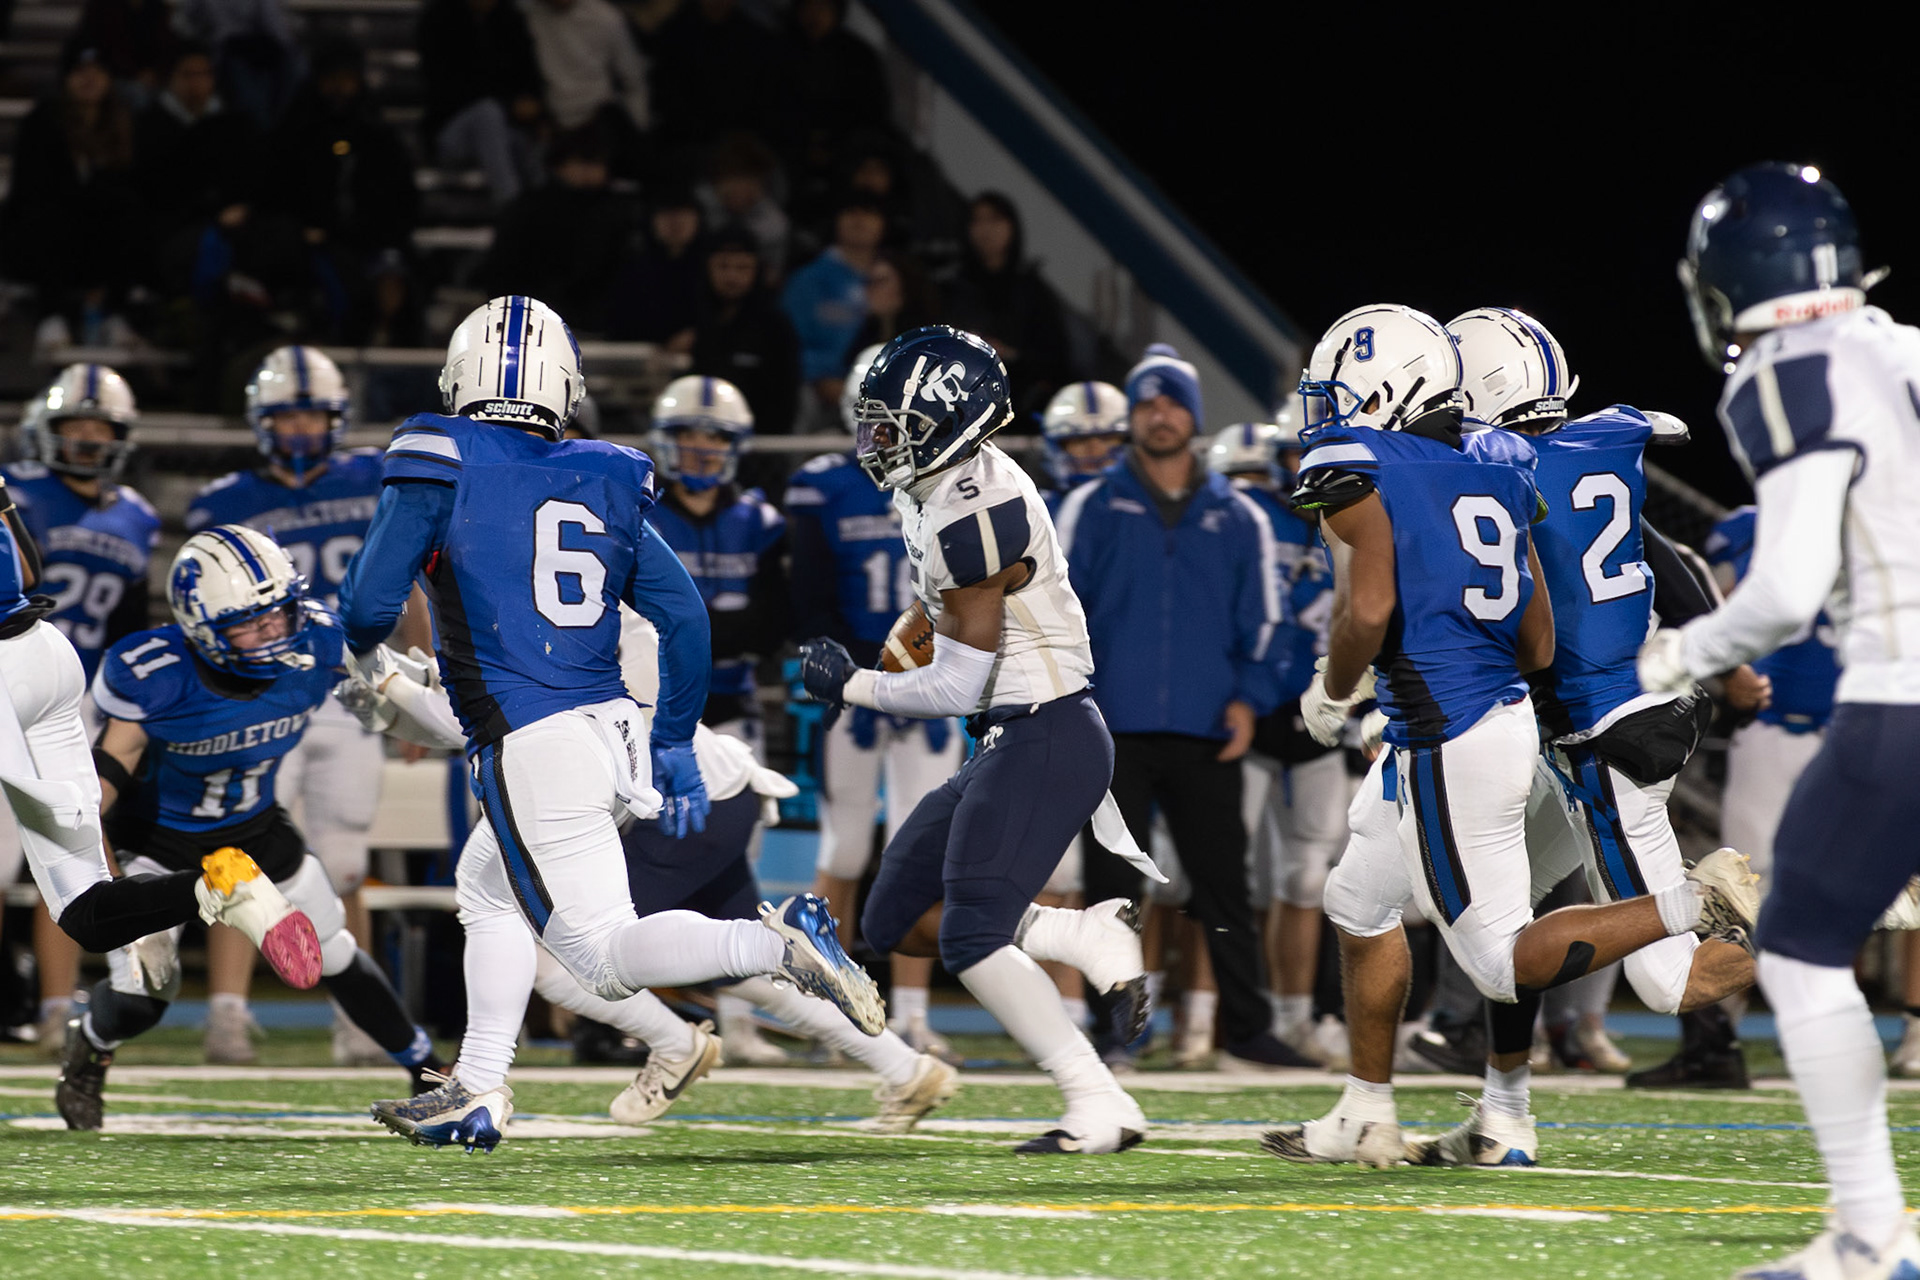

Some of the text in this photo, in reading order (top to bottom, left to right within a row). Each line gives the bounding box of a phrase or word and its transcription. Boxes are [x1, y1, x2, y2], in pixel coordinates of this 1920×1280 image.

[1354, 326, 1375, 363] 9
[485, 400, 534, 416] schutt
[956, 477, 980, 500] 5
[533, 498, 607, 628] 6
[1451, 495, 1520, 621] 9
[1570, 472, 1647, 603] 2
[120, 637, 181, 680] 11
[191, 758, 274, 818] 11
